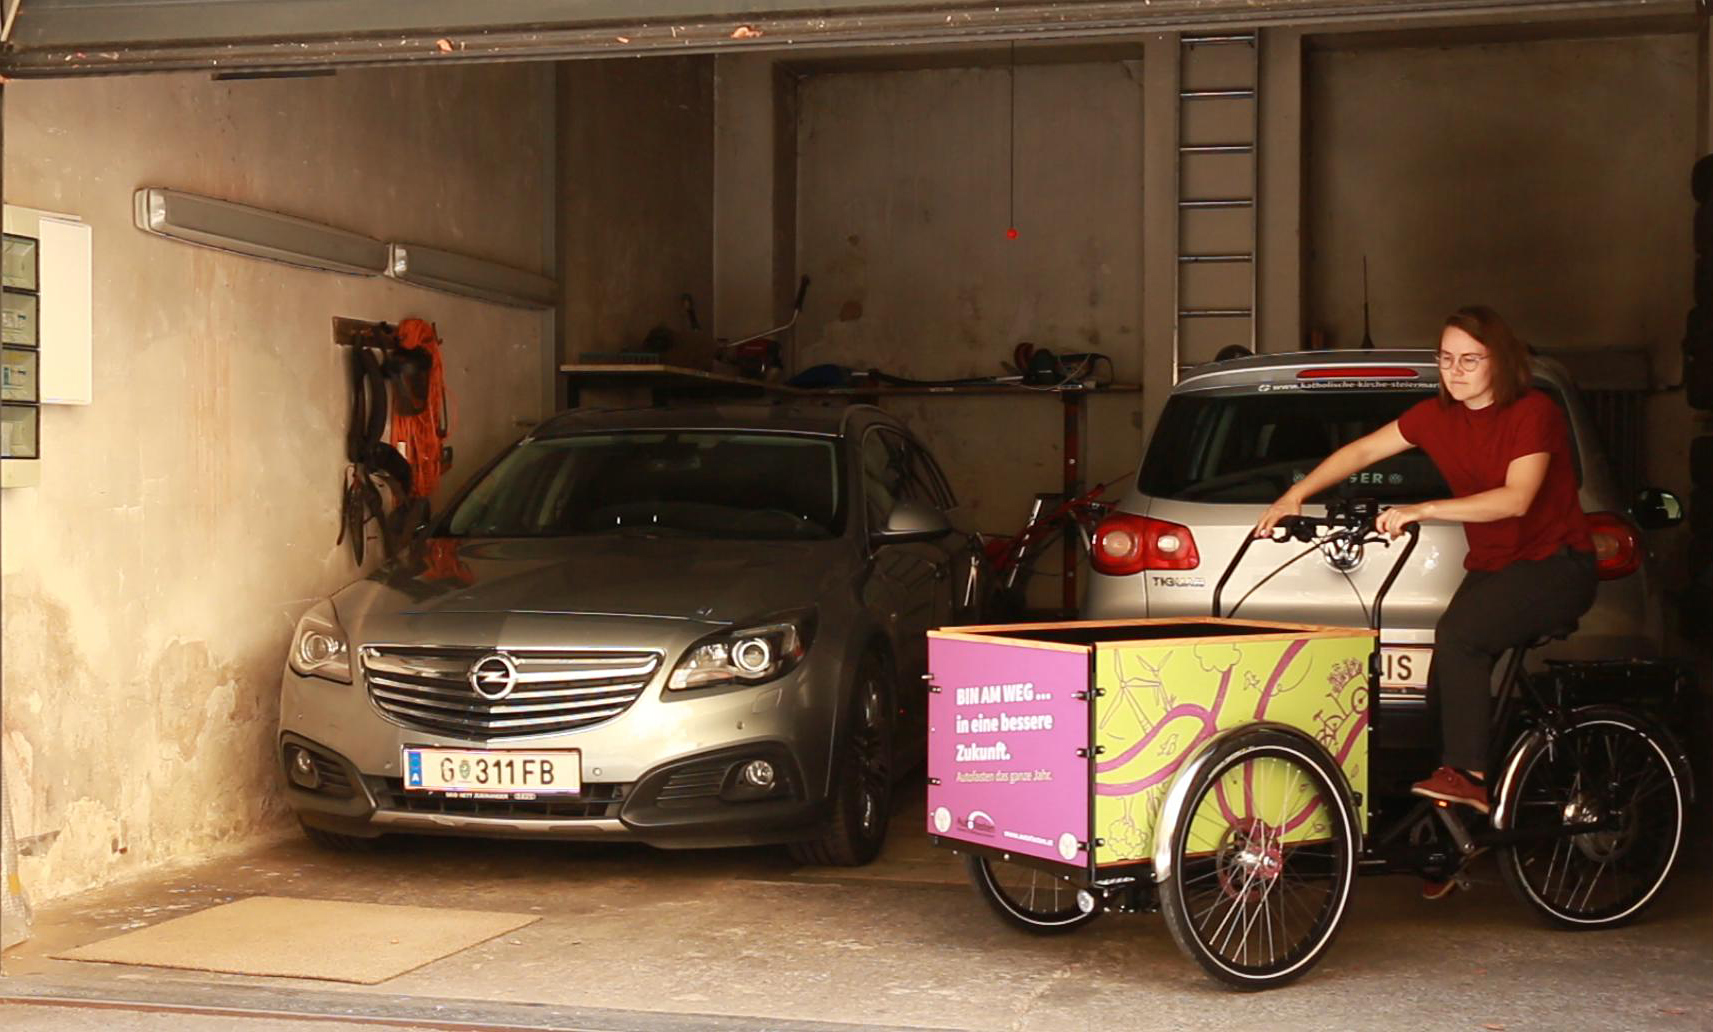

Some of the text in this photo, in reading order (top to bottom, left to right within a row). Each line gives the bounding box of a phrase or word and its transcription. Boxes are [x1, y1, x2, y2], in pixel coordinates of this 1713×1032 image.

[1272, 380, 1440, 391] www.katholische-kirche-steiermar
[955, 687, 979, 706] BIN
[980, 685, 1001, 704] AM
[1002, 682, 1034, 703] WEG
[955, 712, 1053, 734] in eine bessere
[955, 740, 1011, 762] Zukunft.
[440, 757, 455, 783] G
